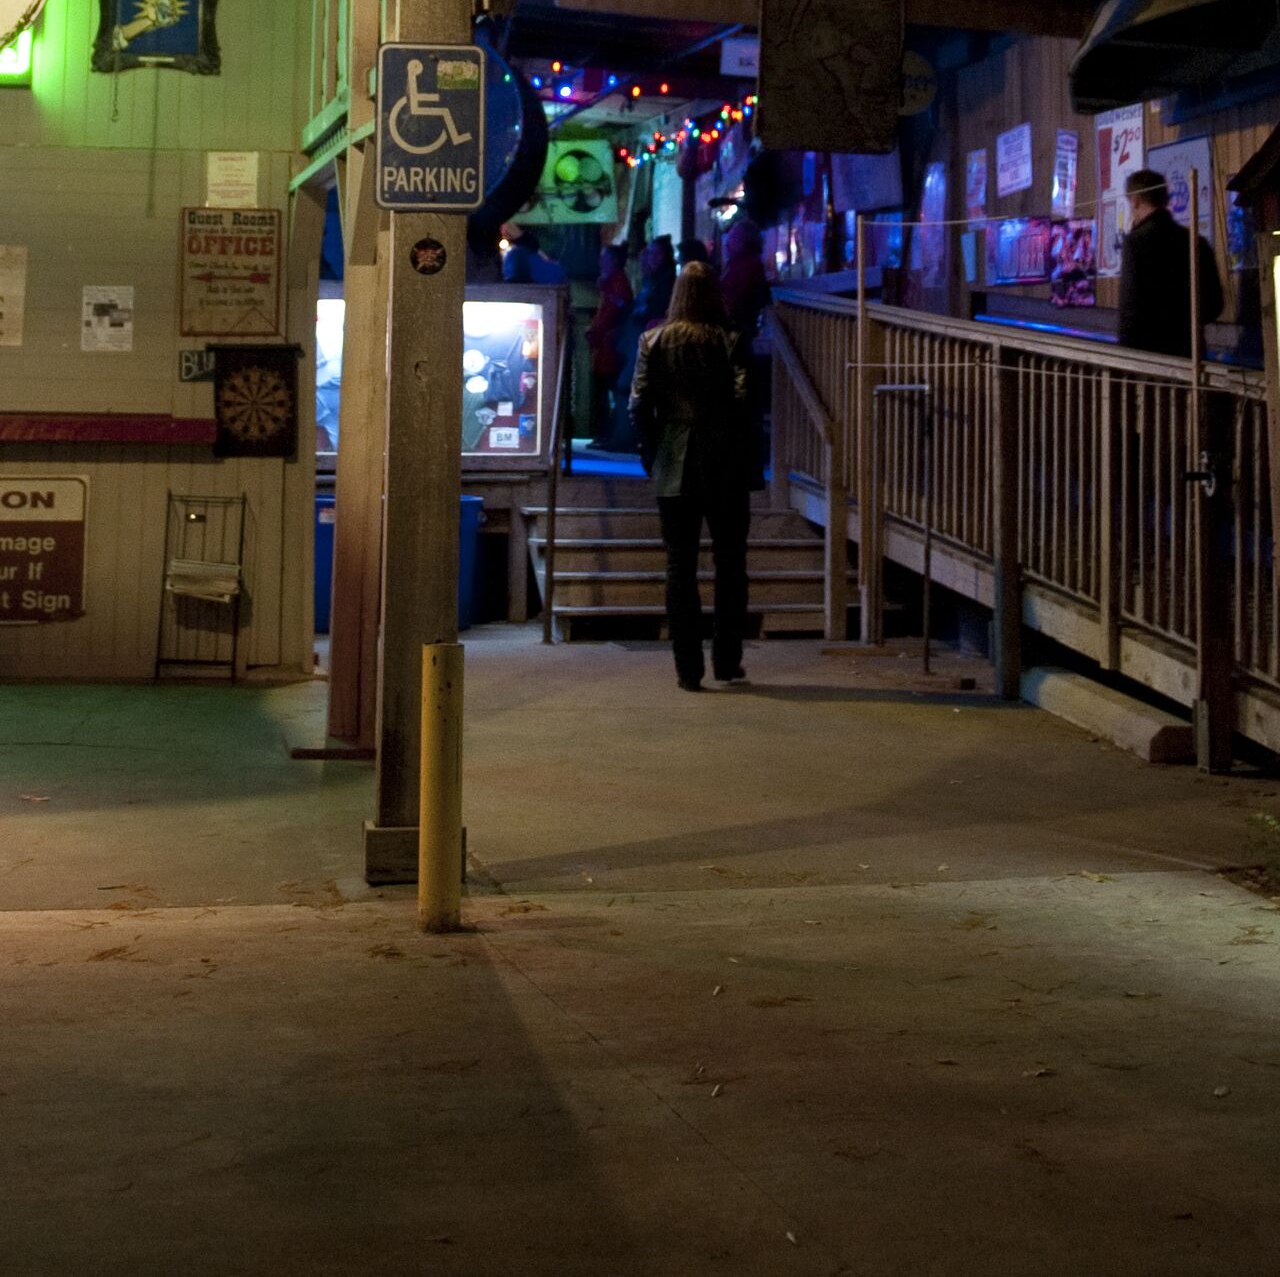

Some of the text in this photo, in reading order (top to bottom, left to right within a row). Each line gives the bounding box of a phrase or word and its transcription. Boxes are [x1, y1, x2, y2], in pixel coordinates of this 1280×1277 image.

[383, 165, 477, 194] PARKING
[187, 235, 274, 256] OFFICE
[181, 351, 215, 380] BLU
[27, 561, 45, 581] If
[21, 589, 71, 613] Sign
